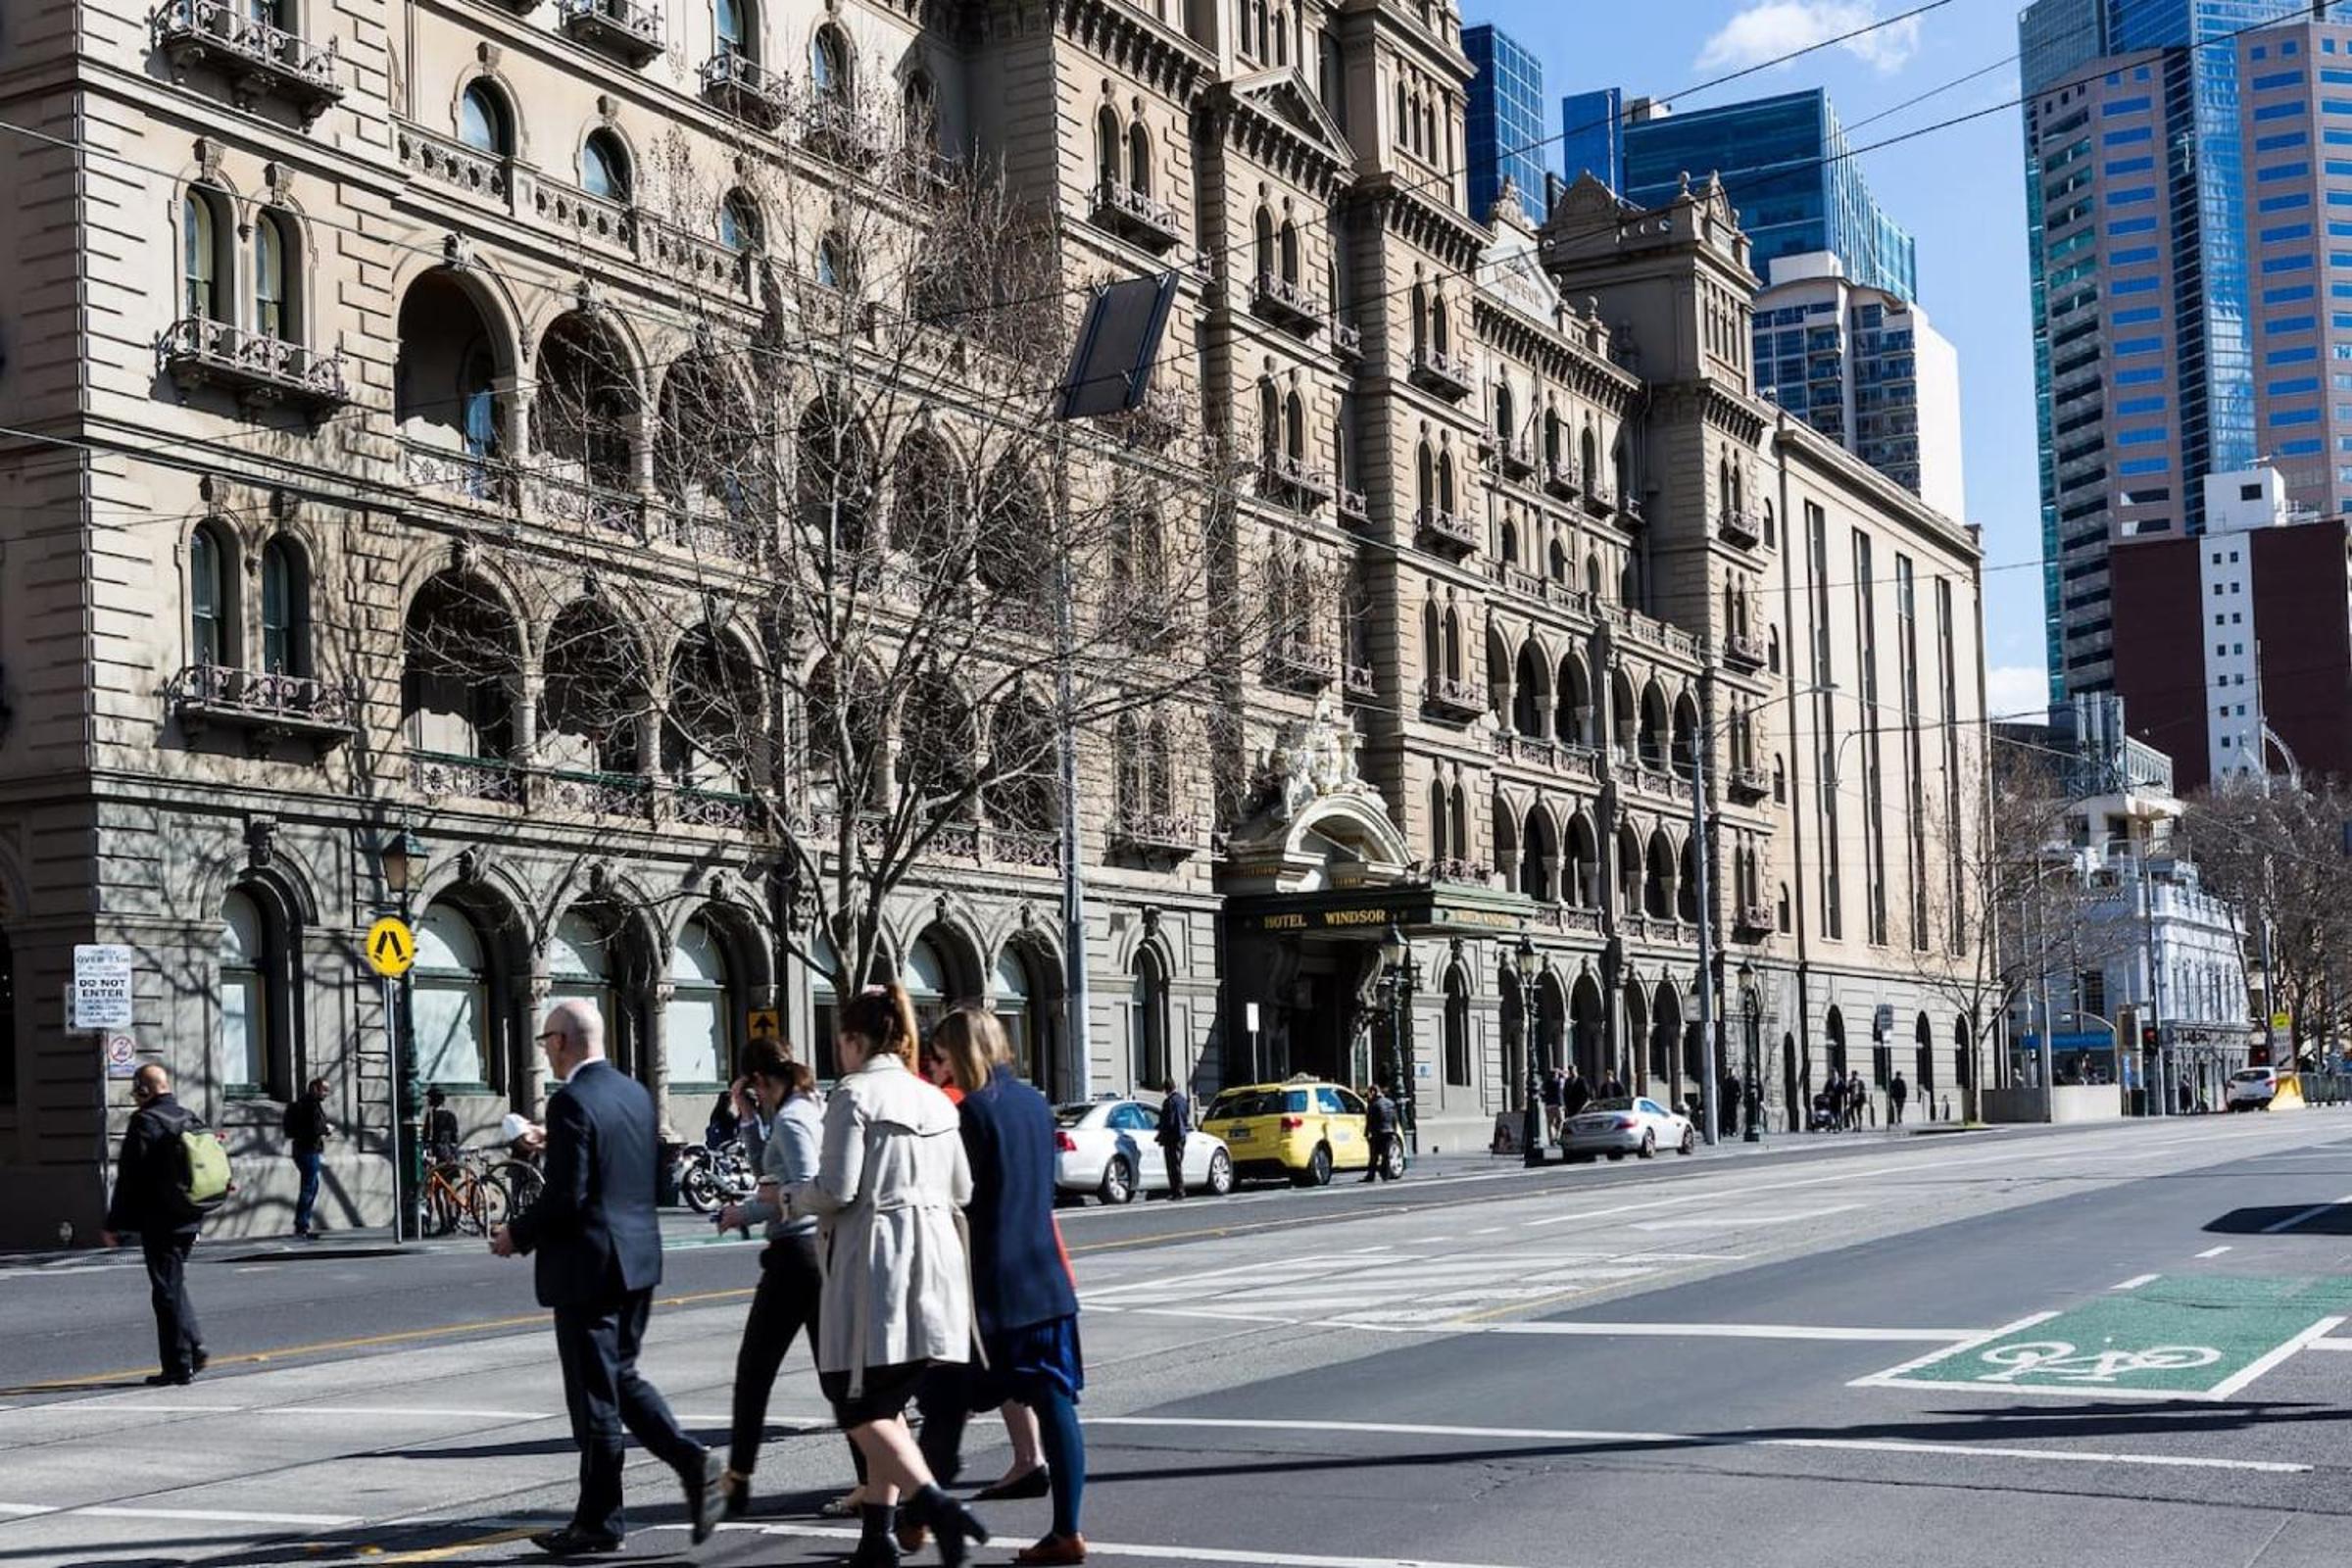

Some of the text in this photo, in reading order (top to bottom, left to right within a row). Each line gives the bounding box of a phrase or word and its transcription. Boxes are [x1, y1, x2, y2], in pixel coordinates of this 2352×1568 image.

[1264, 908, 1387, 929] HOTEL WINDSOR
[82, 989, 123, 998] ENTER
